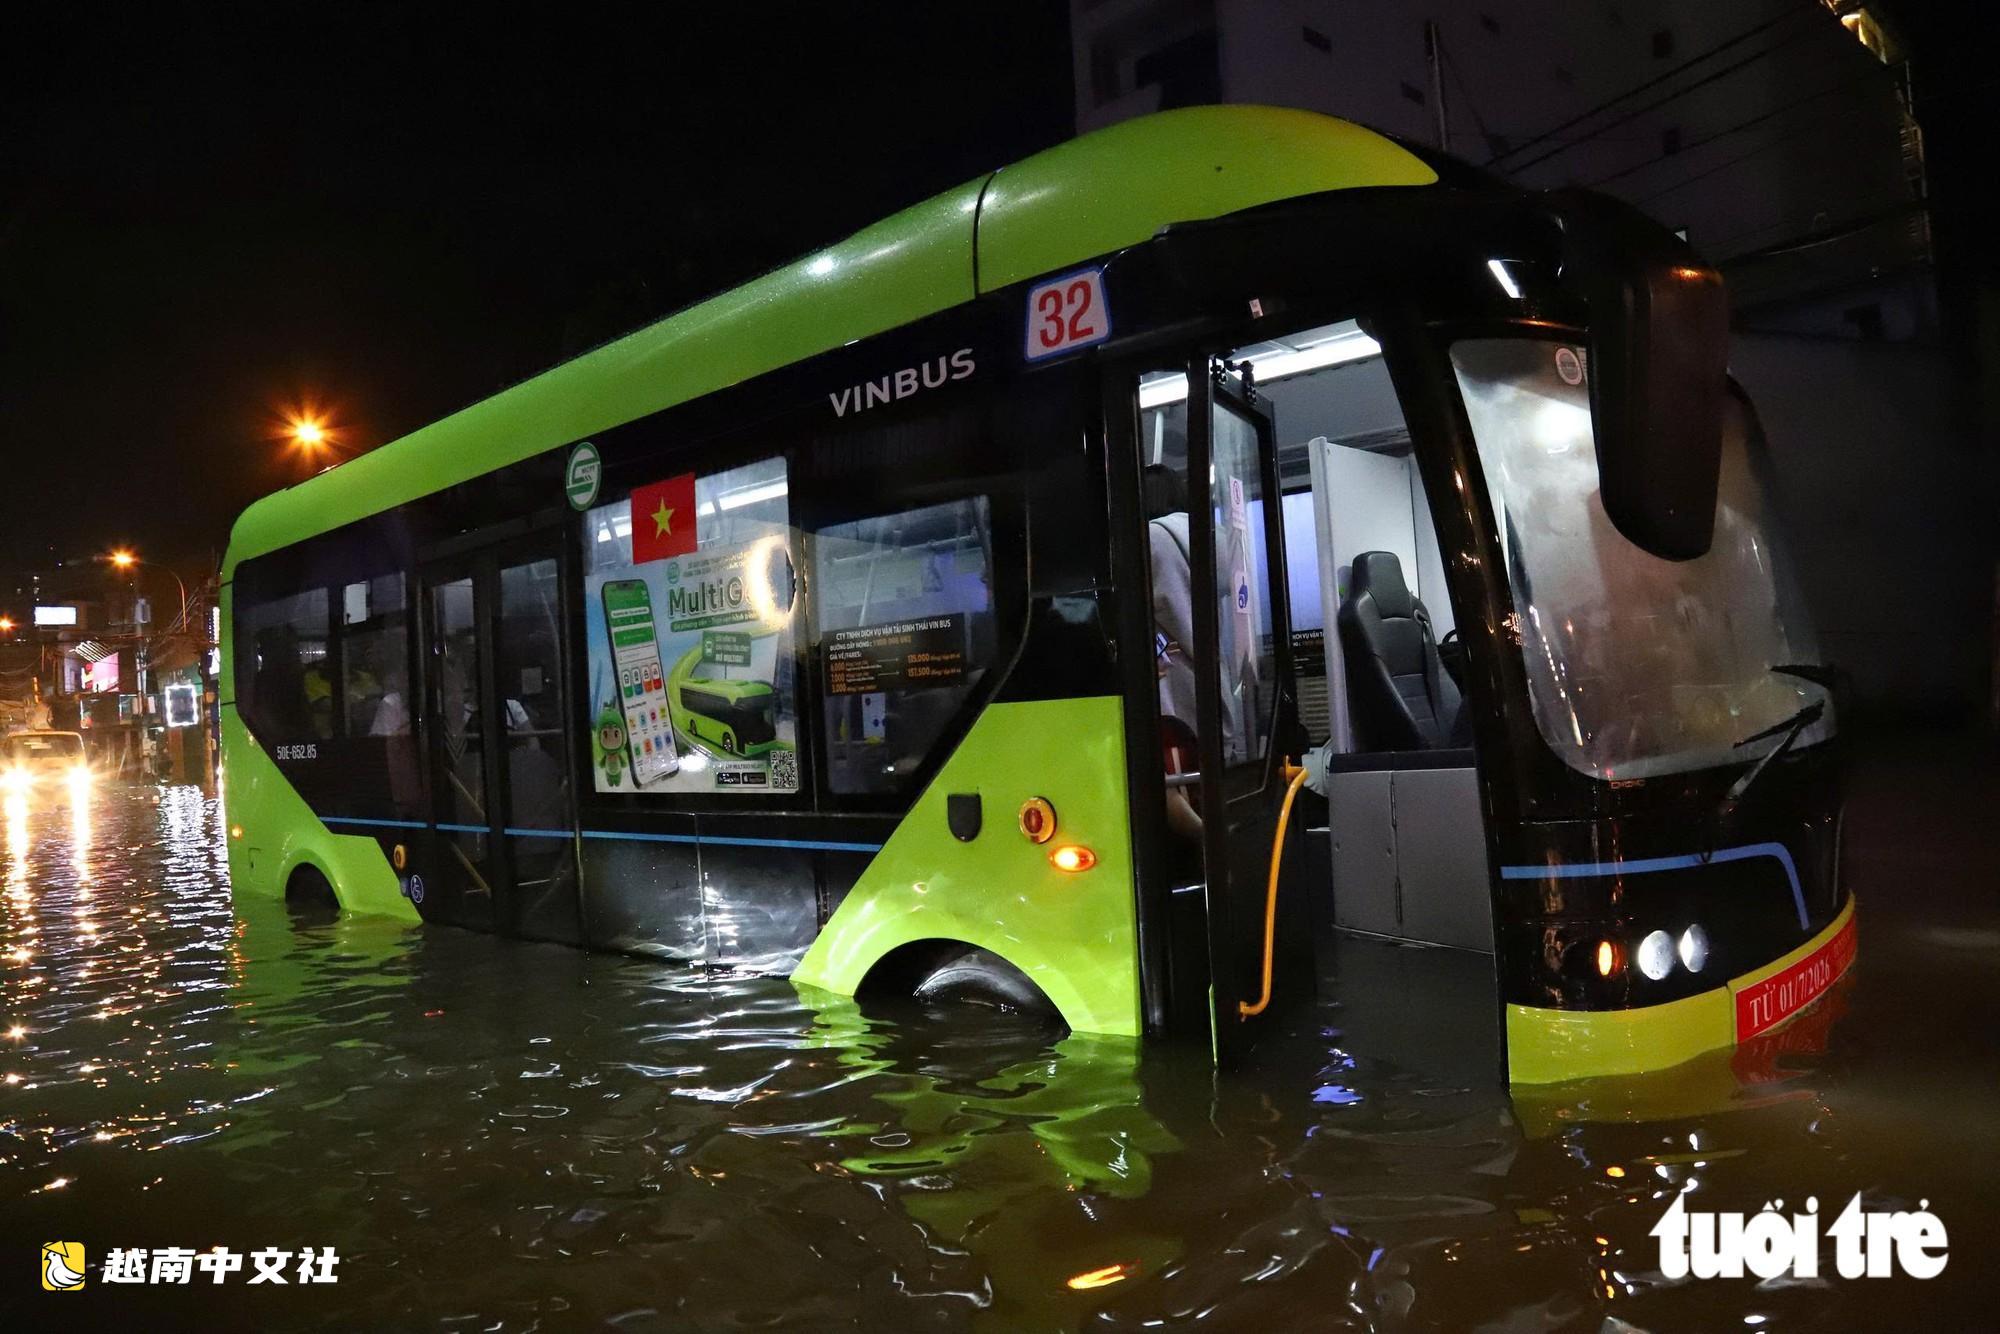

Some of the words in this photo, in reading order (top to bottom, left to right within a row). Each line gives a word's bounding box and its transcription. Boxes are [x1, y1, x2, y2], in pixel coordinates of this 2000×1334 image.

[1037, 280, 1095, 349] 32
[829, 348, 976, 418] VINBUS
[668, 577, 749, 618] MultiG
[902, 624, 915, 633] SINH
[929, 620, 939, 629] VIN
[939, 619, 951, 629] BUS
[276, 743, 317, 760] 50E-652.85
[1749, 983, 1776, 1029] TỪ
[1779, 956, 1831, 1013] 01/7/2026
